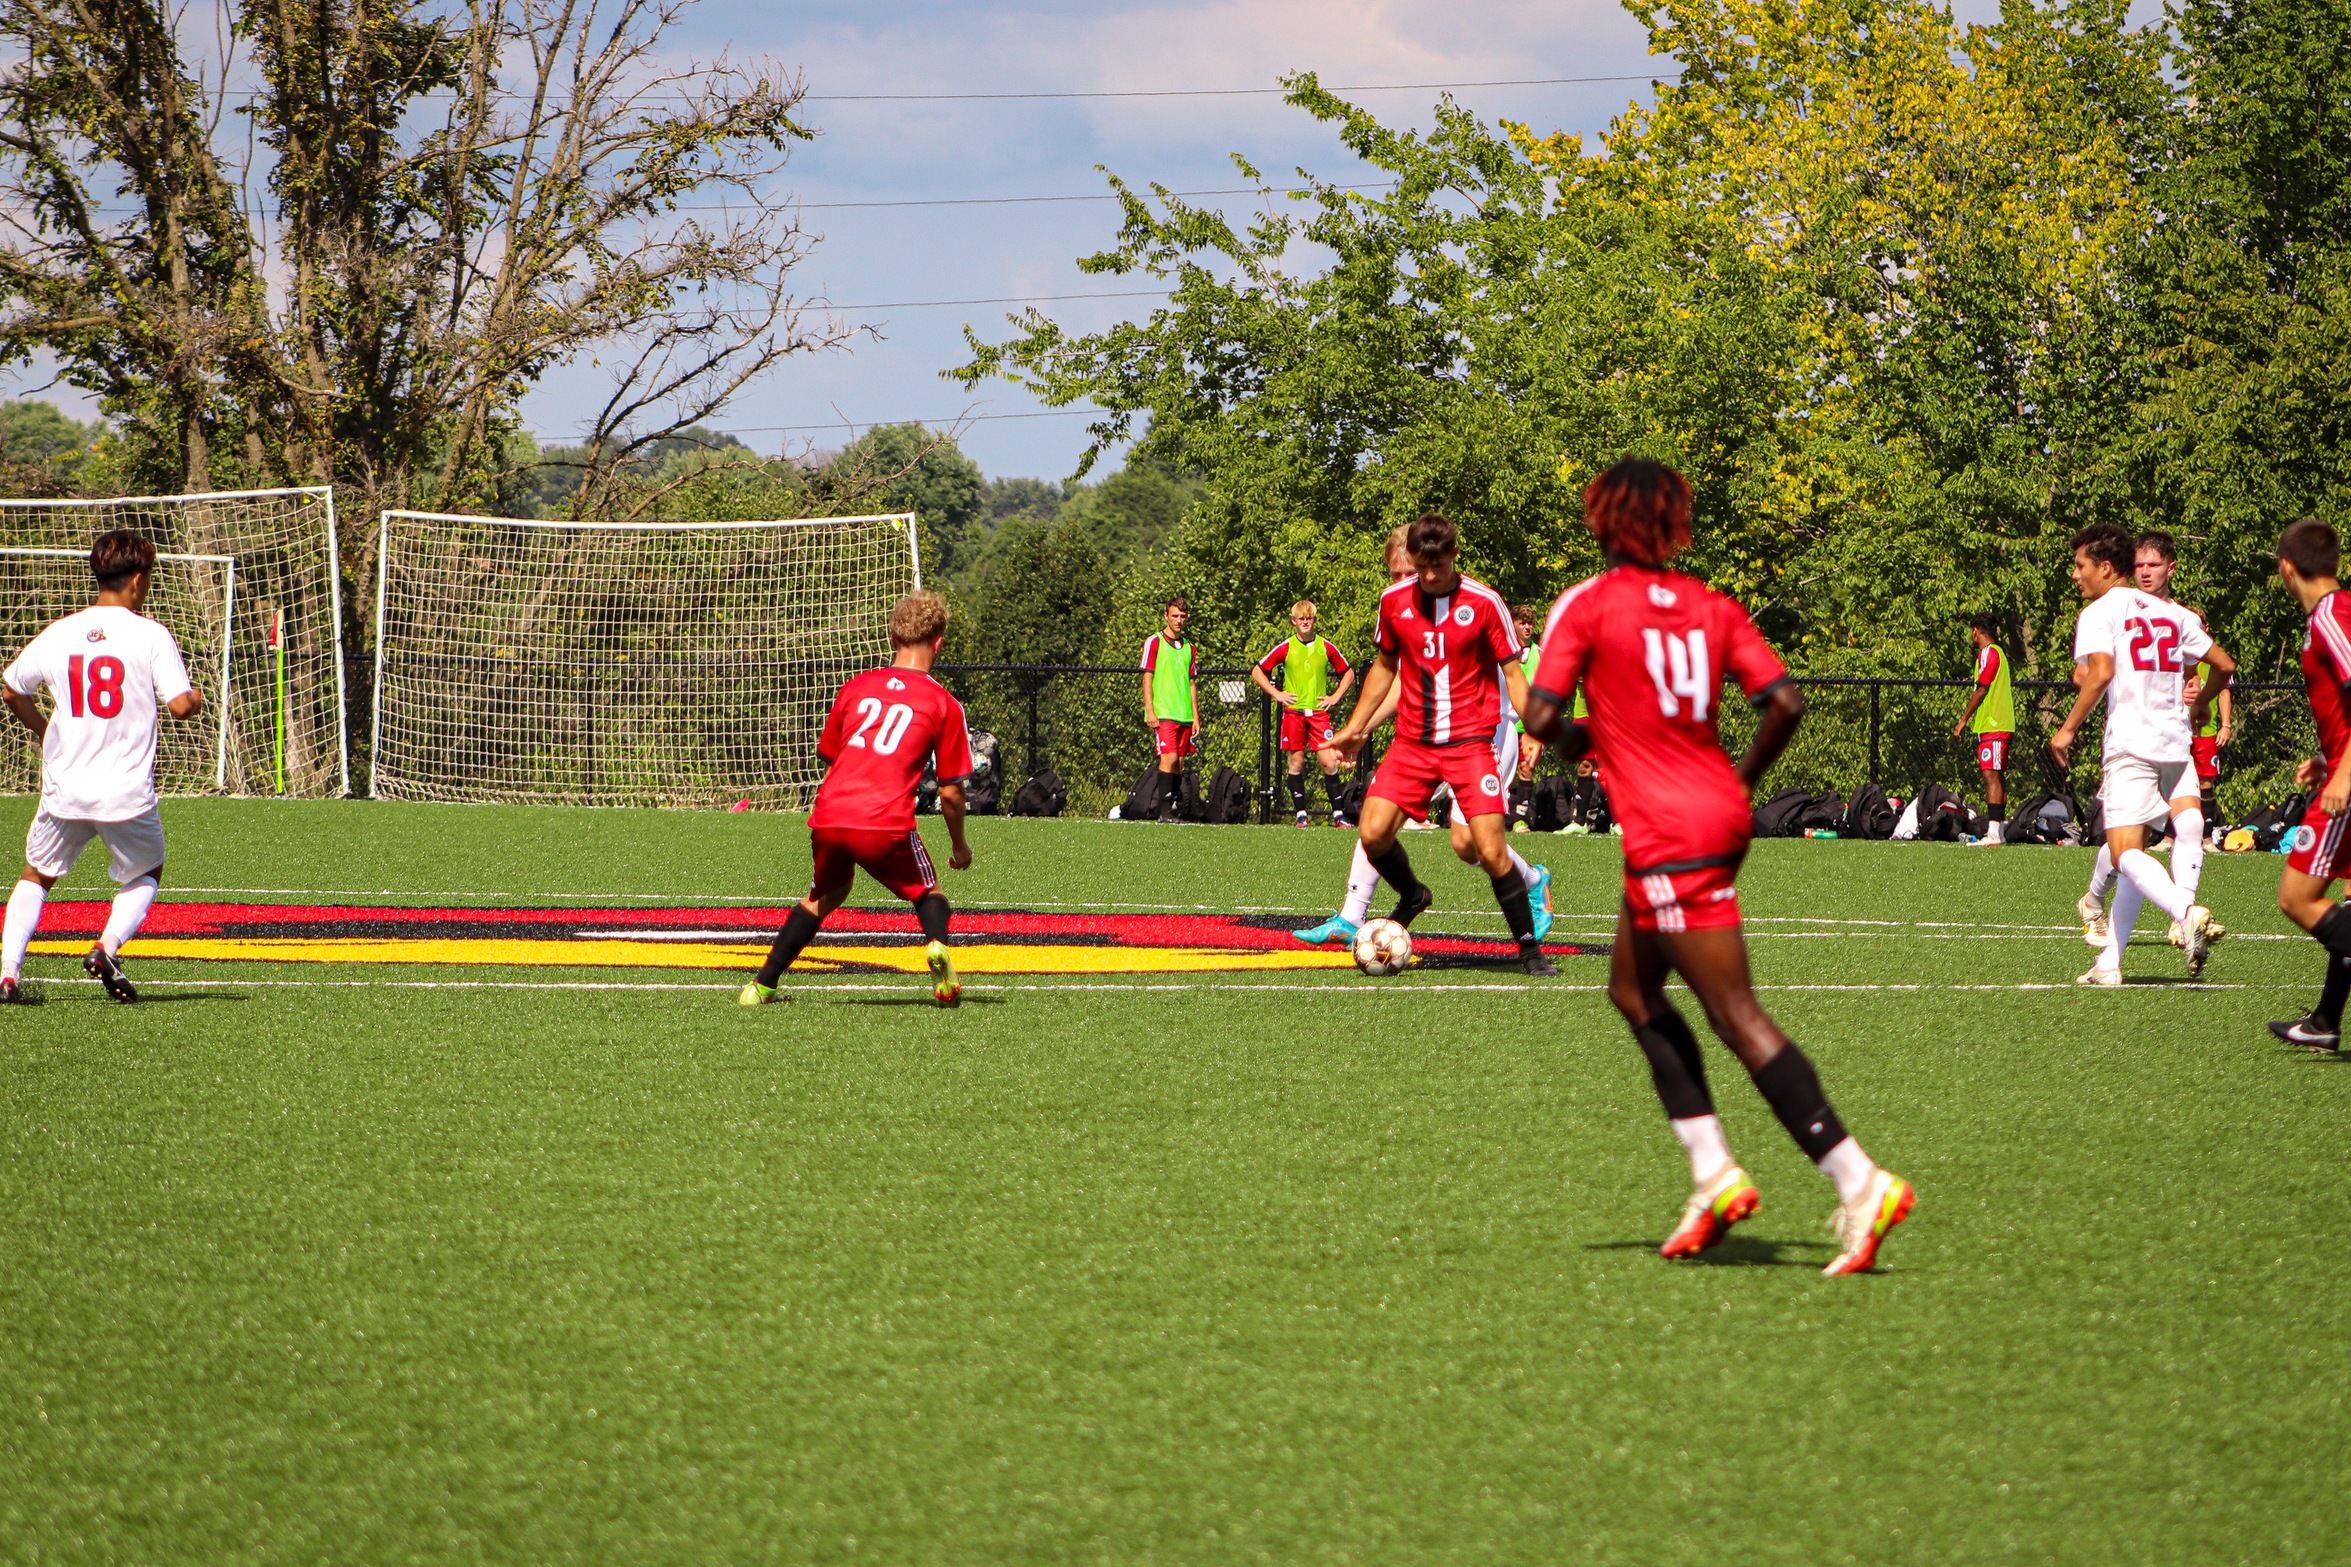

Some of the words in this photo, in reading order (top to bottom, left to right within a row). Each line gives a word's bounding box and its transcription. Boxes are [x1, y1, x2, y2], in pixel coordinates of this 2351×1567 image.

[1303, 660, 1311, 673] 6
[1423, 631, 1445, 660] 31
[2124, 616, 2182, 673] 22
[68, 654, 125, 719] 18
[1640, 627, 1710, 722] 14
[847, 697, 914, 756] 20
